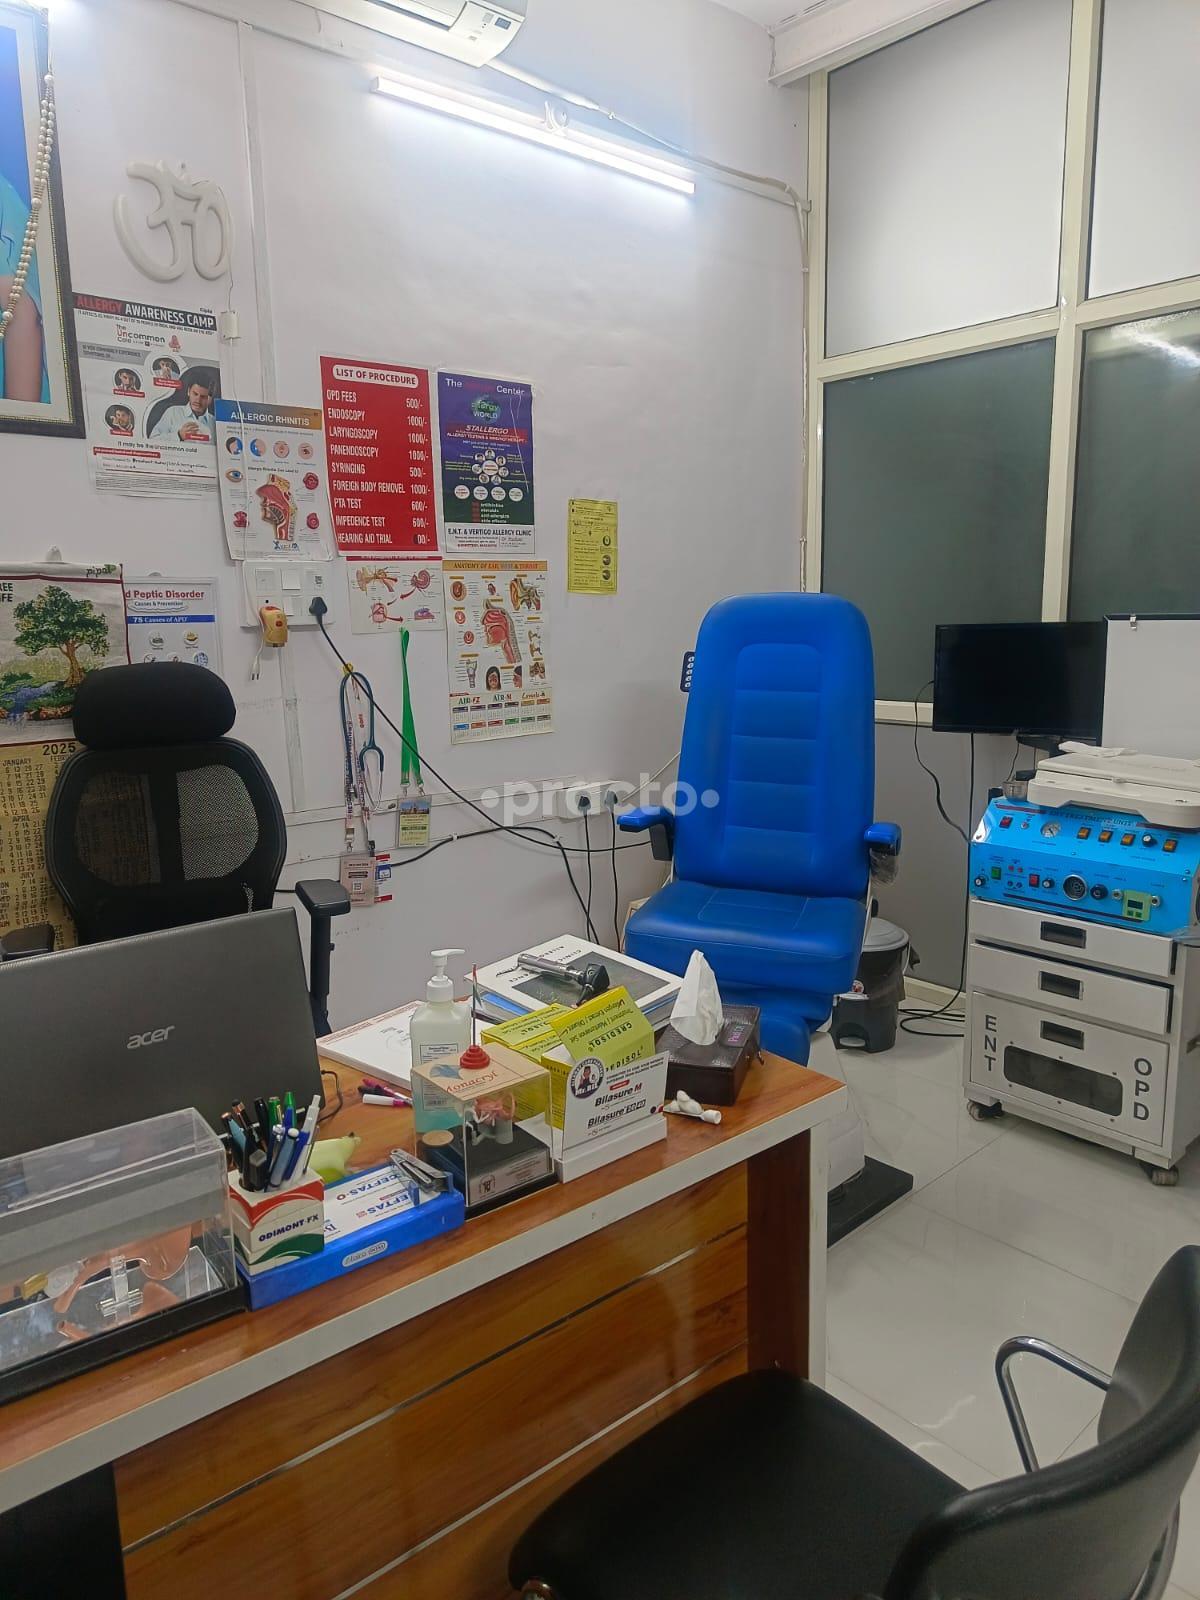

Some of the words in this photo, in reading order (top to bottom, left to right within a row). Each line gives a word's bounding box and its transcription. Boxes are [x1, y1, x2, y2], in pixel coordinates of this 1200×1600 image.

[78, 296, 122, 313] ALLERGY
[126, 304, 184, 323] AWARENESS
[187, 312, 214, 328] CAMP
[118, 330, 165, 342] Uncommon
[336, 367, 353, 377] LIST
[356, 370, 366, 378] OF
[369, 372, 415, 384] PROCEDURE
[446, 378, 462, 387] The
[496, 386, 524, 395] Center
[327, 390, 339, 401] OPD
[342, 390, 356, 402] FEES
[406, 398, 423, 409] 500/-
[231, 411, 273, 422] ALLERGIC
[276, 416, 310, 425] RHINITIS
[328, 408, 365, 421] ENDOSCOPY
[408, 416, 427, 426] 1000/-
[329, 428, 378, 440] LARYNGOSCOPY
[408, 433, 428, 444] 1000/-
[466, 425, 508, 434] STALLERGO
[331, 445, 378, 457] PANENDOSCOPY
[408, 450, 428, 461] 1000/-
[332, 462, 365, 474] SYRINGING
[410, 467, 426, 478] 500/-
[333, 480, 359, 491] FOREIGN
[361, 481, 376, 492] BODY
[378, 482, 405, 493] REMOVEL
[410, 484, 430, 494] 1000/-
[334, 498, 346, 508] PTA
[347, 498, 361, 508] TEST
[336, 516, 370, 527] IMPEDENCE
[371, 516, 385, 527] TEST
[338, 533, 363, 544] HEARING
[365, 534, 374, 544] AID
[376, 533, 392, 544] TRIAL
[0, 594, 13, 602] FE
[134, 590, 163, 599] Peptic
[166, 590, 204, 598] Disorder
[42, 742, 76, 756] 2025
[3, 758, 31, 766] JANUARY
[127, 1025, 175, 1049] acer
[591, 1022, 633, 1049] CREDISOL
[985, 1015, 997, 1072] ENT
[595, 1087, 633, 1107] Bilasure
[634, 1083, 642, 1092] M
[1133, 1058, 1152, 1121] OPD
[588, 1109, 624, 1129] Bilasure
[368, 1194, 410, 1214] EFTAS
